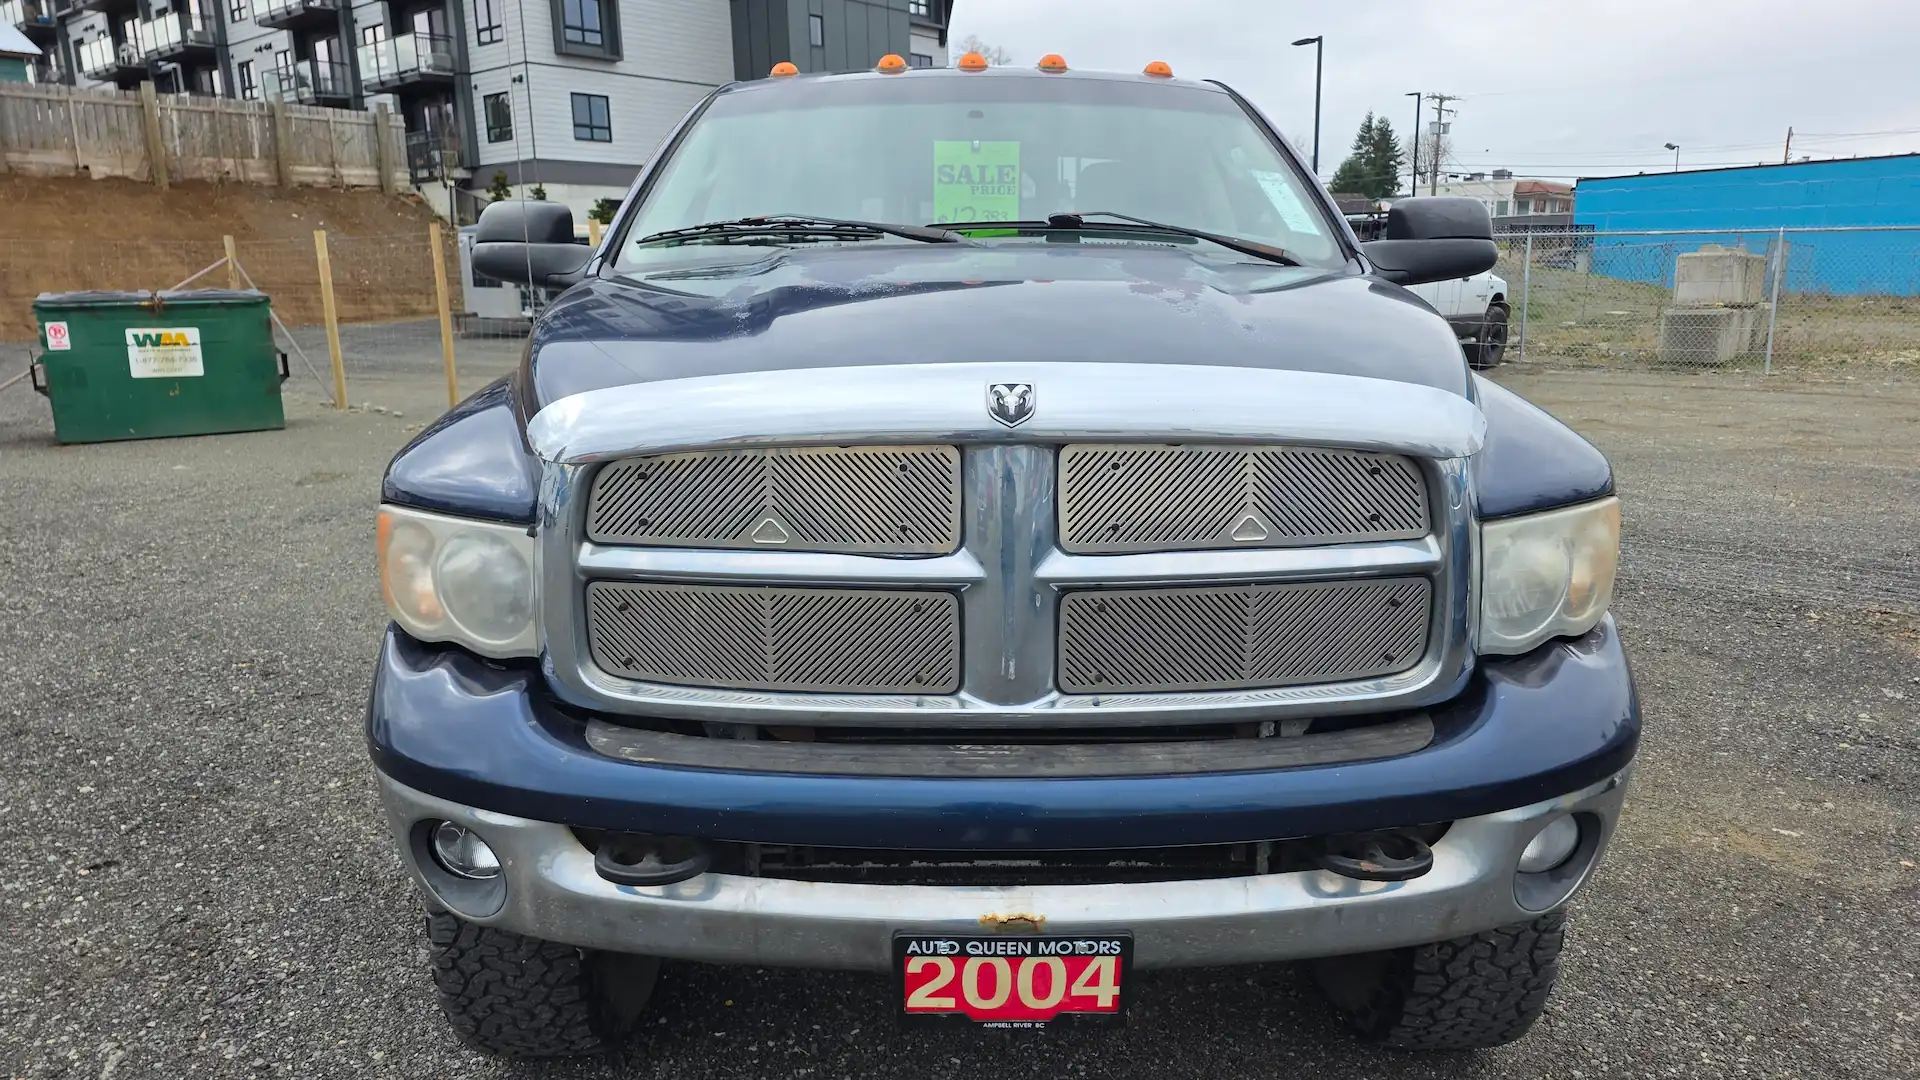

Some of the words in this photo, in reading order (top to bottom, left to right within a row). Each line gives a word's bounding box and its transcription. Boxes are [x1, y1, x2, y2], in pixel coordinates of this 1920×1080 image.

[937, 164, 1016, 185] SALE
[970, 185, 1016, 196] PRICE
[906, 940, 960, 954] AUTO
[965, 940, 1031, 954] QUEEN
[1038, 940, 1121, 954] MOTORS
[906, 956, 1120, 1010] 2004
